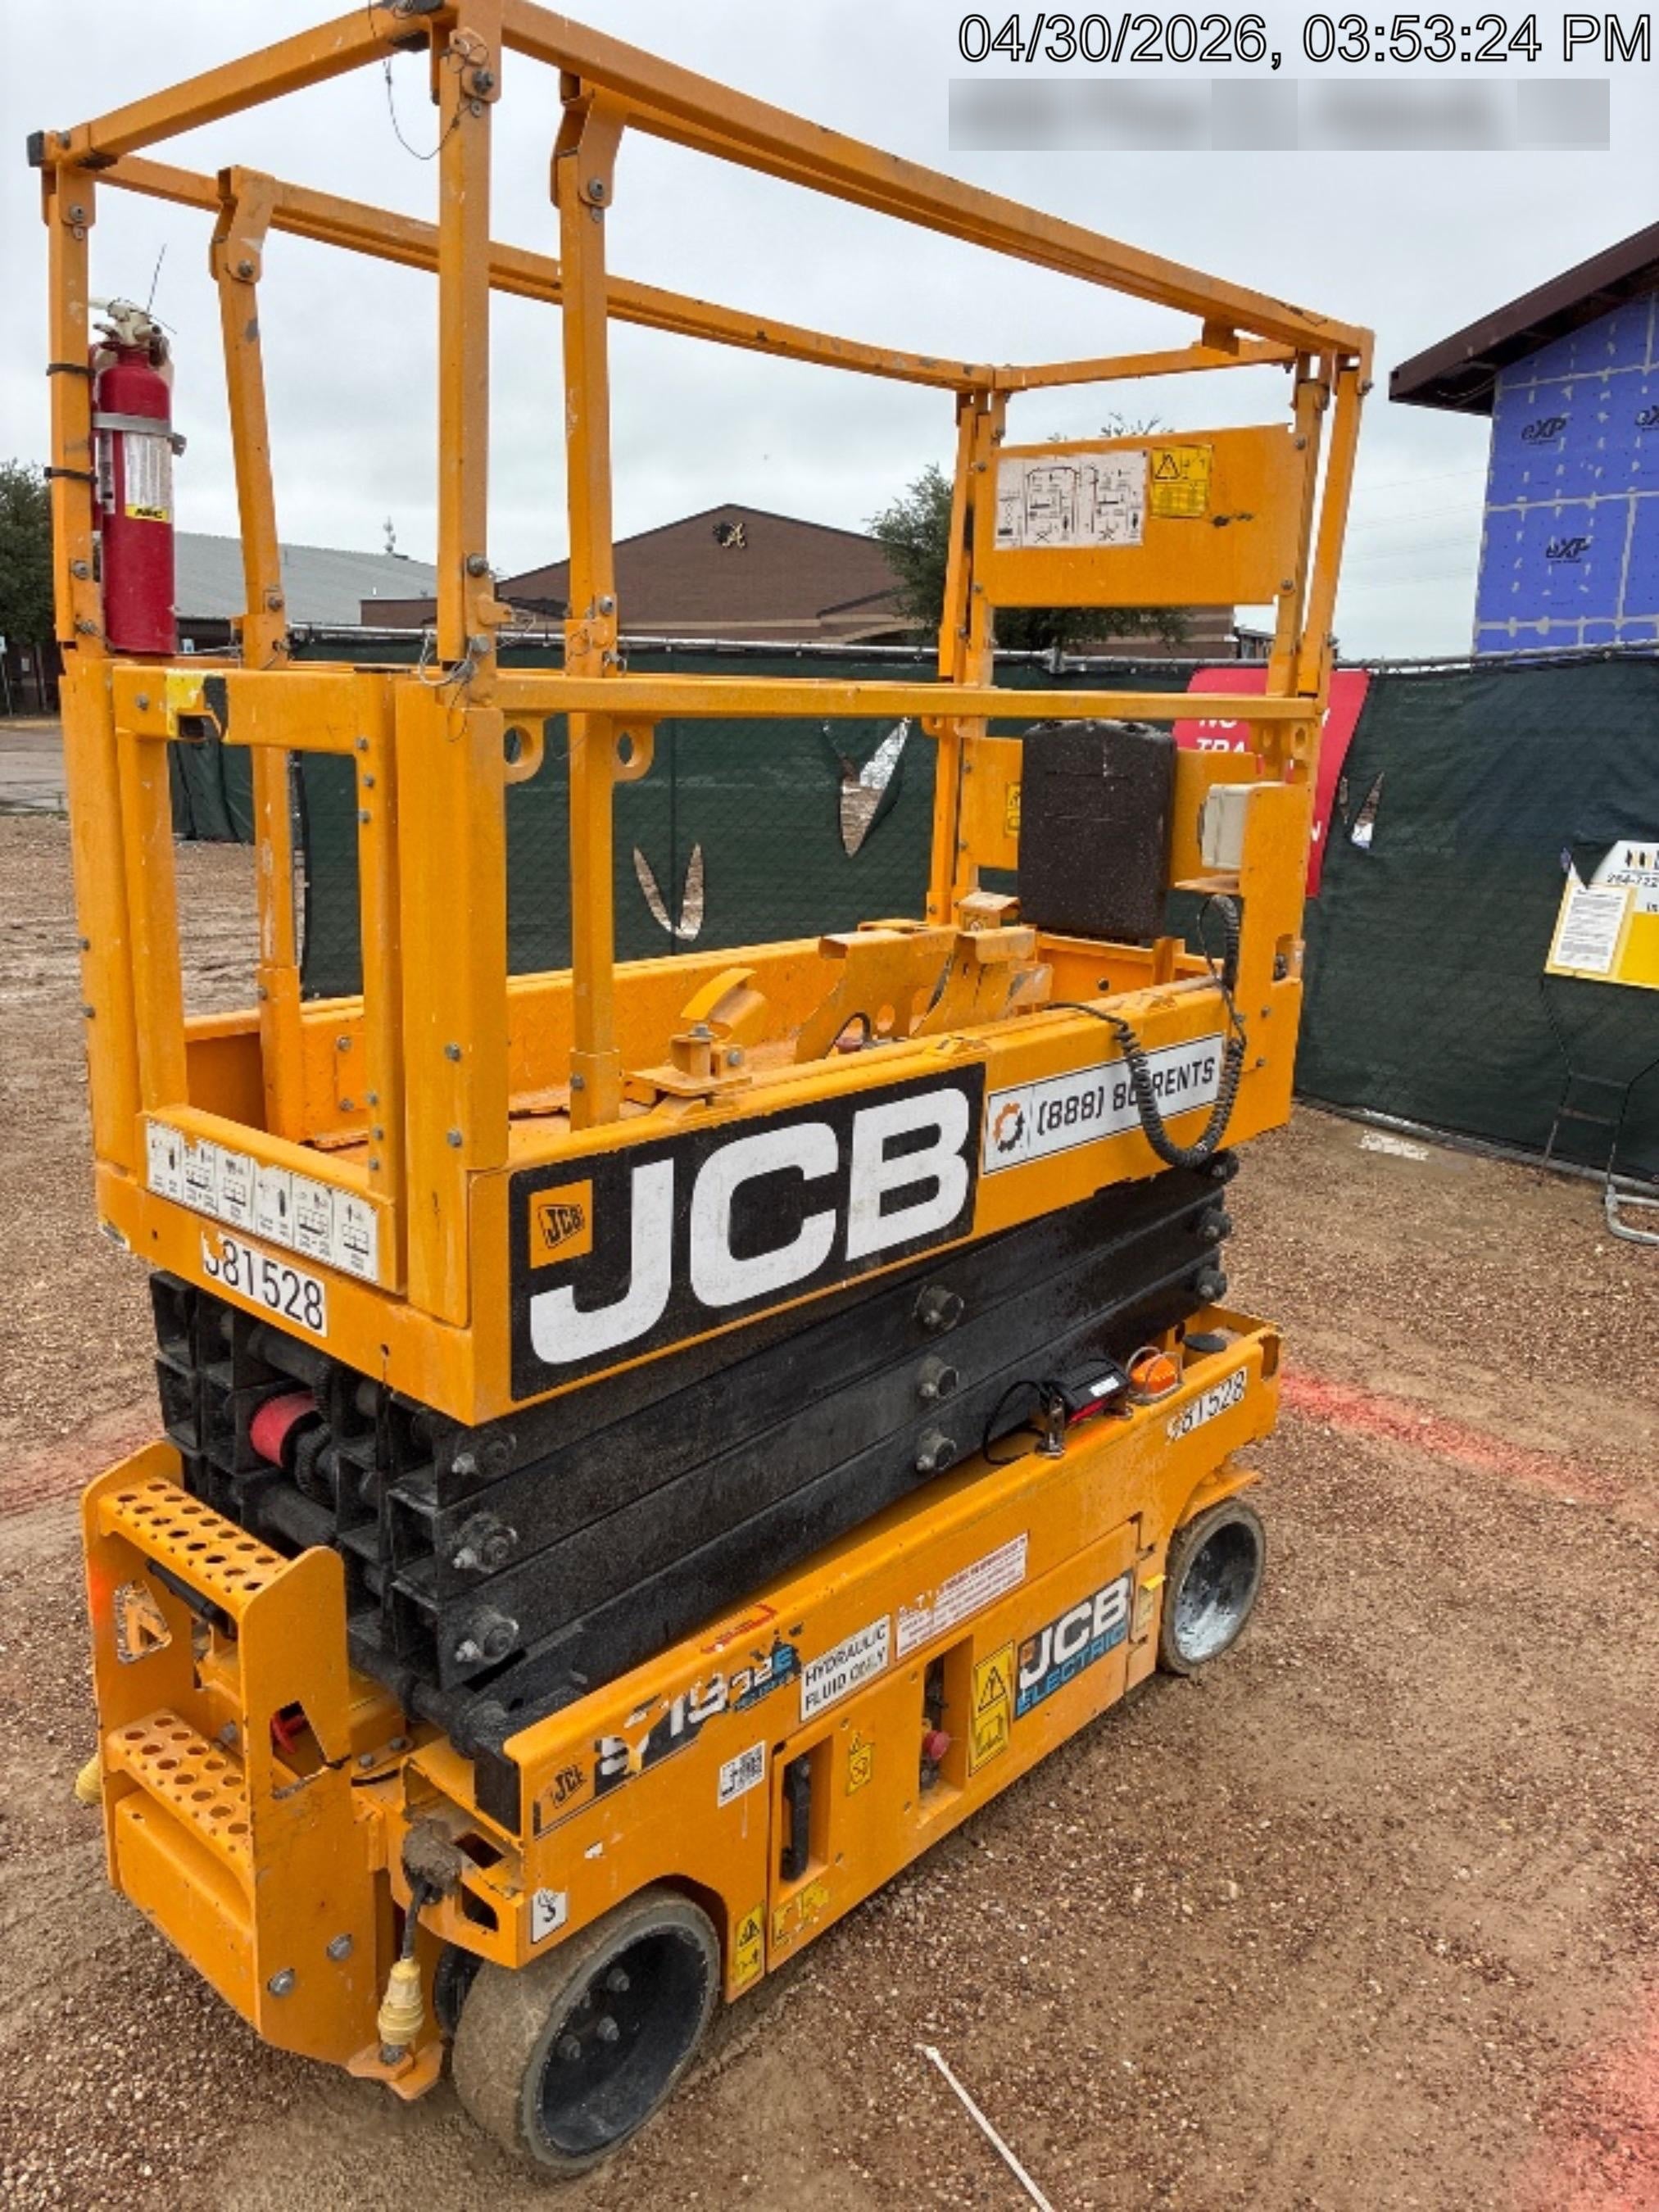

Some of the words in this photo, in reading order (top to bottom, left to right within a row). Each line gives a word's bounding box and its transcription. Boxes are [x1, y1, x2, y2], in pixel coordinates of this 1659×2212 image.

[1037, 1086, 1104, 1136] (888)
[530, 1087, 969, 1365] JCB
[546, 1206, 582, 1243] JCB
[1173, 1371, 1244, 1440] 81528
[1019, 1575, 1130, 1690] JCB
[805, 1672, 846, 1711] FLUID
[1017, 1620, 1126, 1716] ELECTRIC
